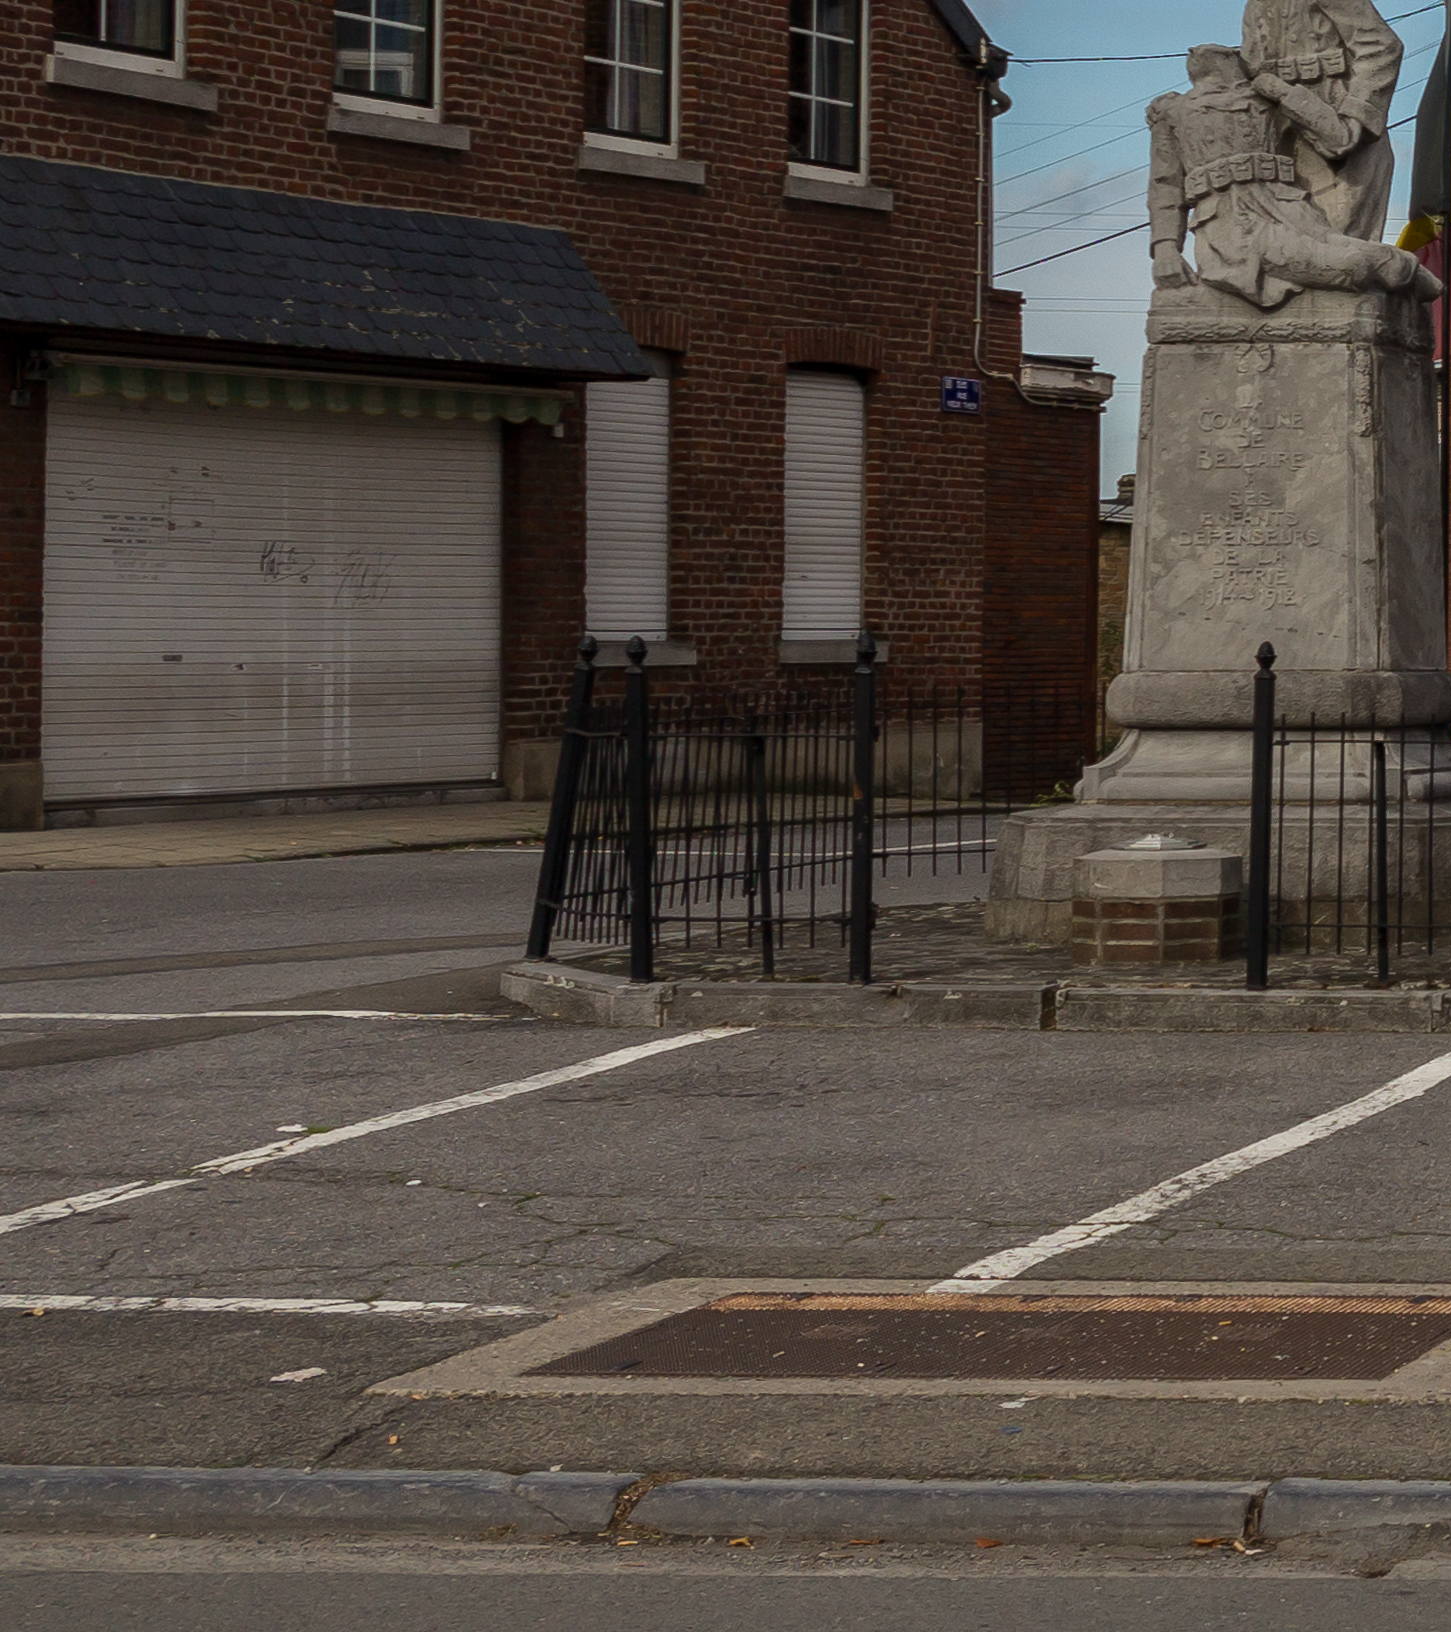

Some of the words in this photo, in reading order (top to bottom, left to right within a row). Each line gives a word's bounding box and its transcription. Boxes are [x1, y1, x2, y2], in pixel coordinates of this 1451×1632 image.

[1200, 409, 1304, 432] COMMUNE
[1237, 431, 1265, 449] DE
[1197, 449, 1306, 472] BELLAIRE
[1229, 490, 1272, 507] SES
[1200, 511, 1300, 528] ENFANTS
[1178, 528, 1321, 547] DEFENSEURS
[1212, 549, 1240, 566] DE
[1258, 549, 1287, 566] LA
[1211, 568, 1289, 586] PATRIE
